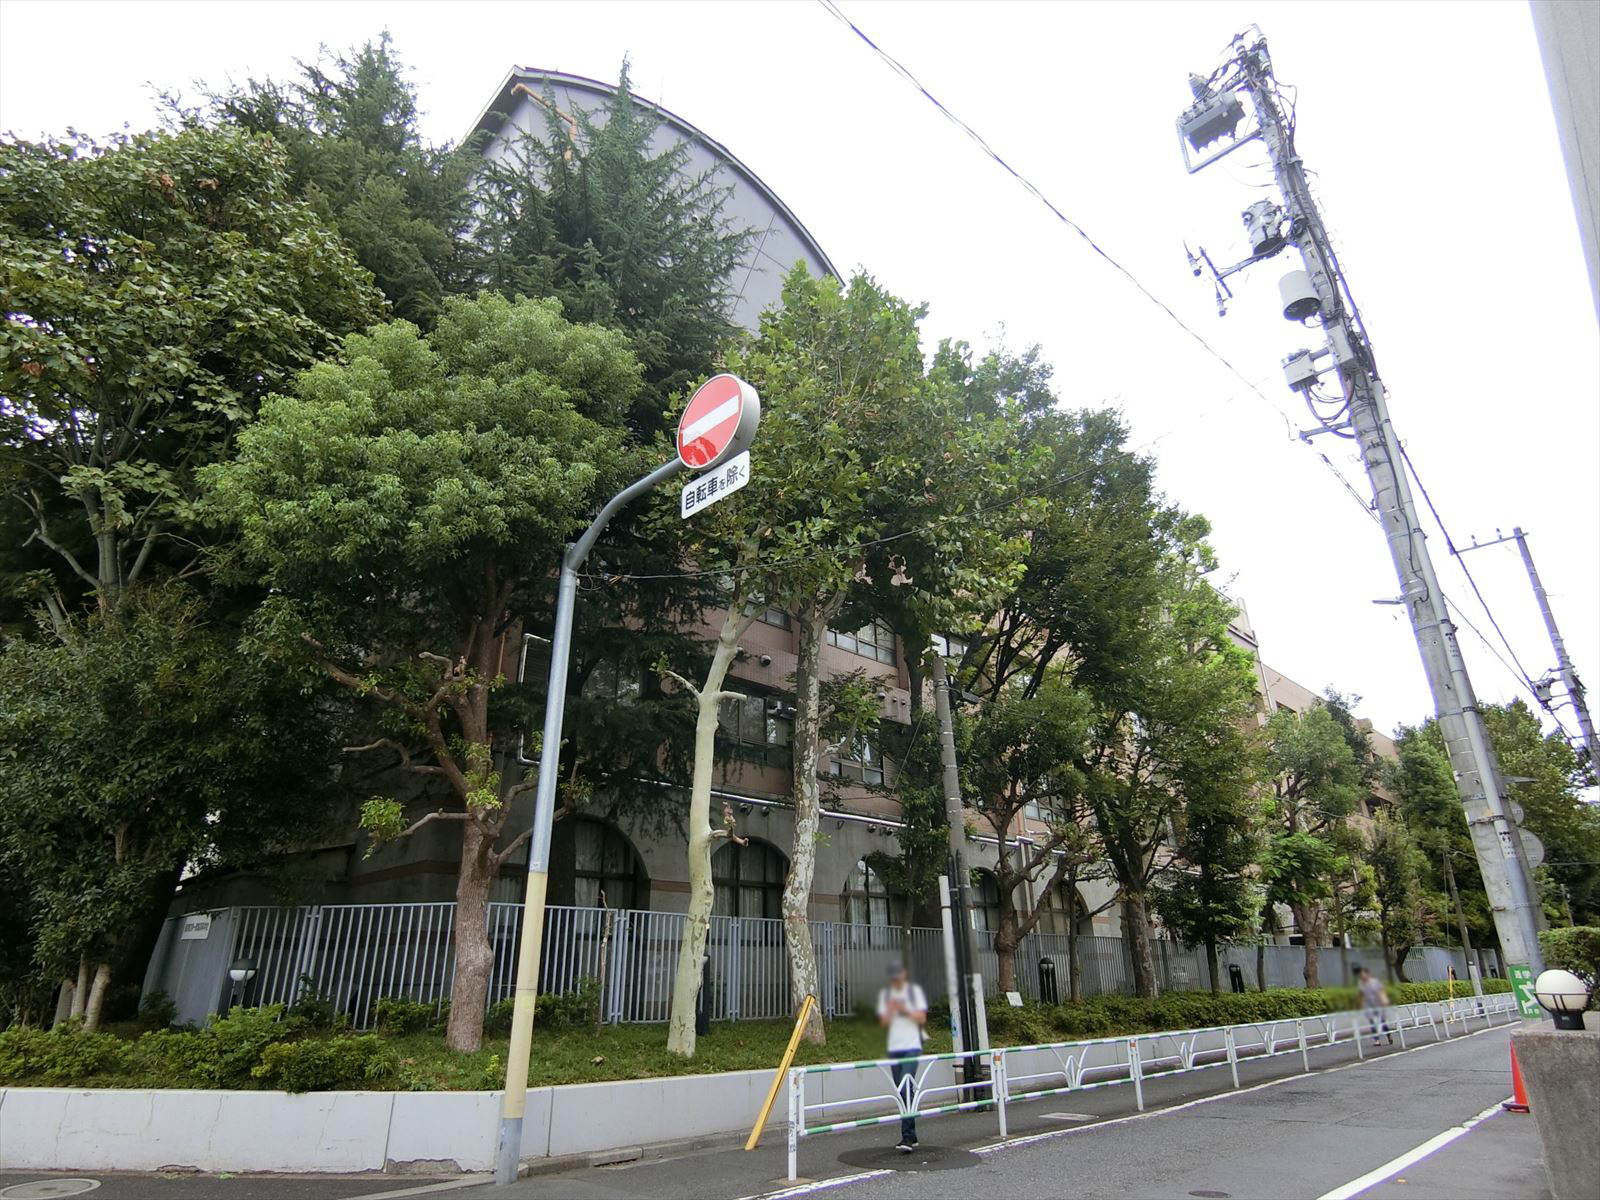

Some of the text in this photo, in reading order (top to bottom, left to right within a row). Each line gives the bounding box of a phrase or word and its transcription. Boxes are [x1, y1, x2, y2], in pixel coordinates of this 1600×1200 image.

[685, 465, 745, 510] 自転車を除く
